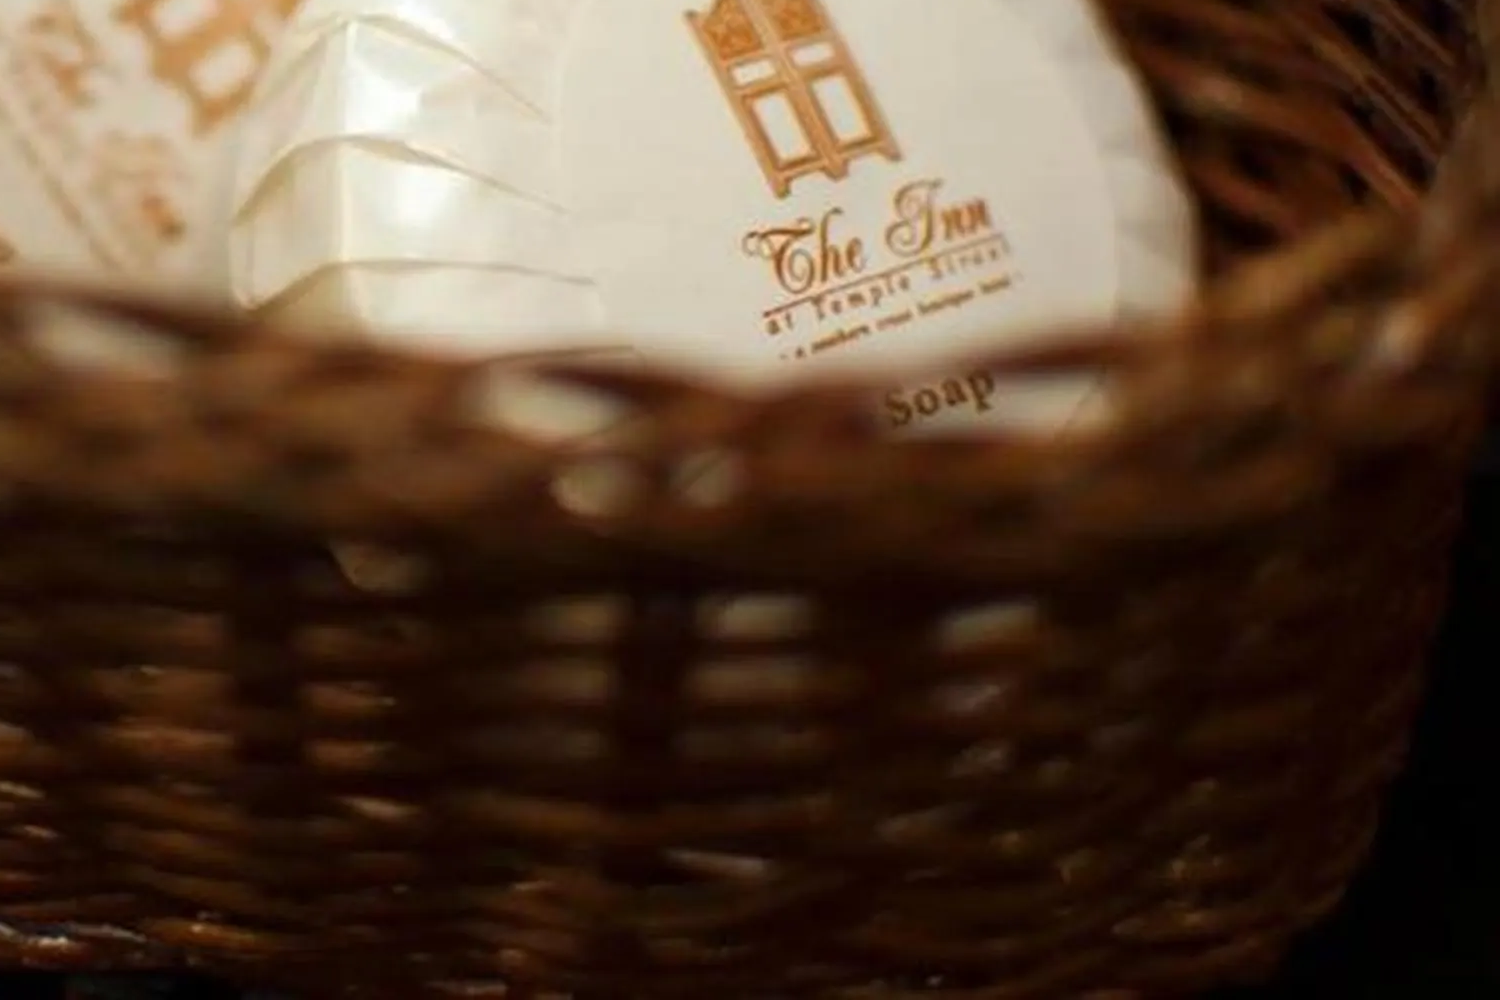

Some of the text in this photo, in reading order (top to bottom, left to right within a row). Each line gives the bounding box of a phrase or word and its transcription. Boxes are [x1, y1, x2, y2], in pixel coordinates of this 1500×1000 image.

[741, 177, 992, 295] The Inn
[810, 271, 911, 321] Temple
[883, 367, 997, 429] Soap
